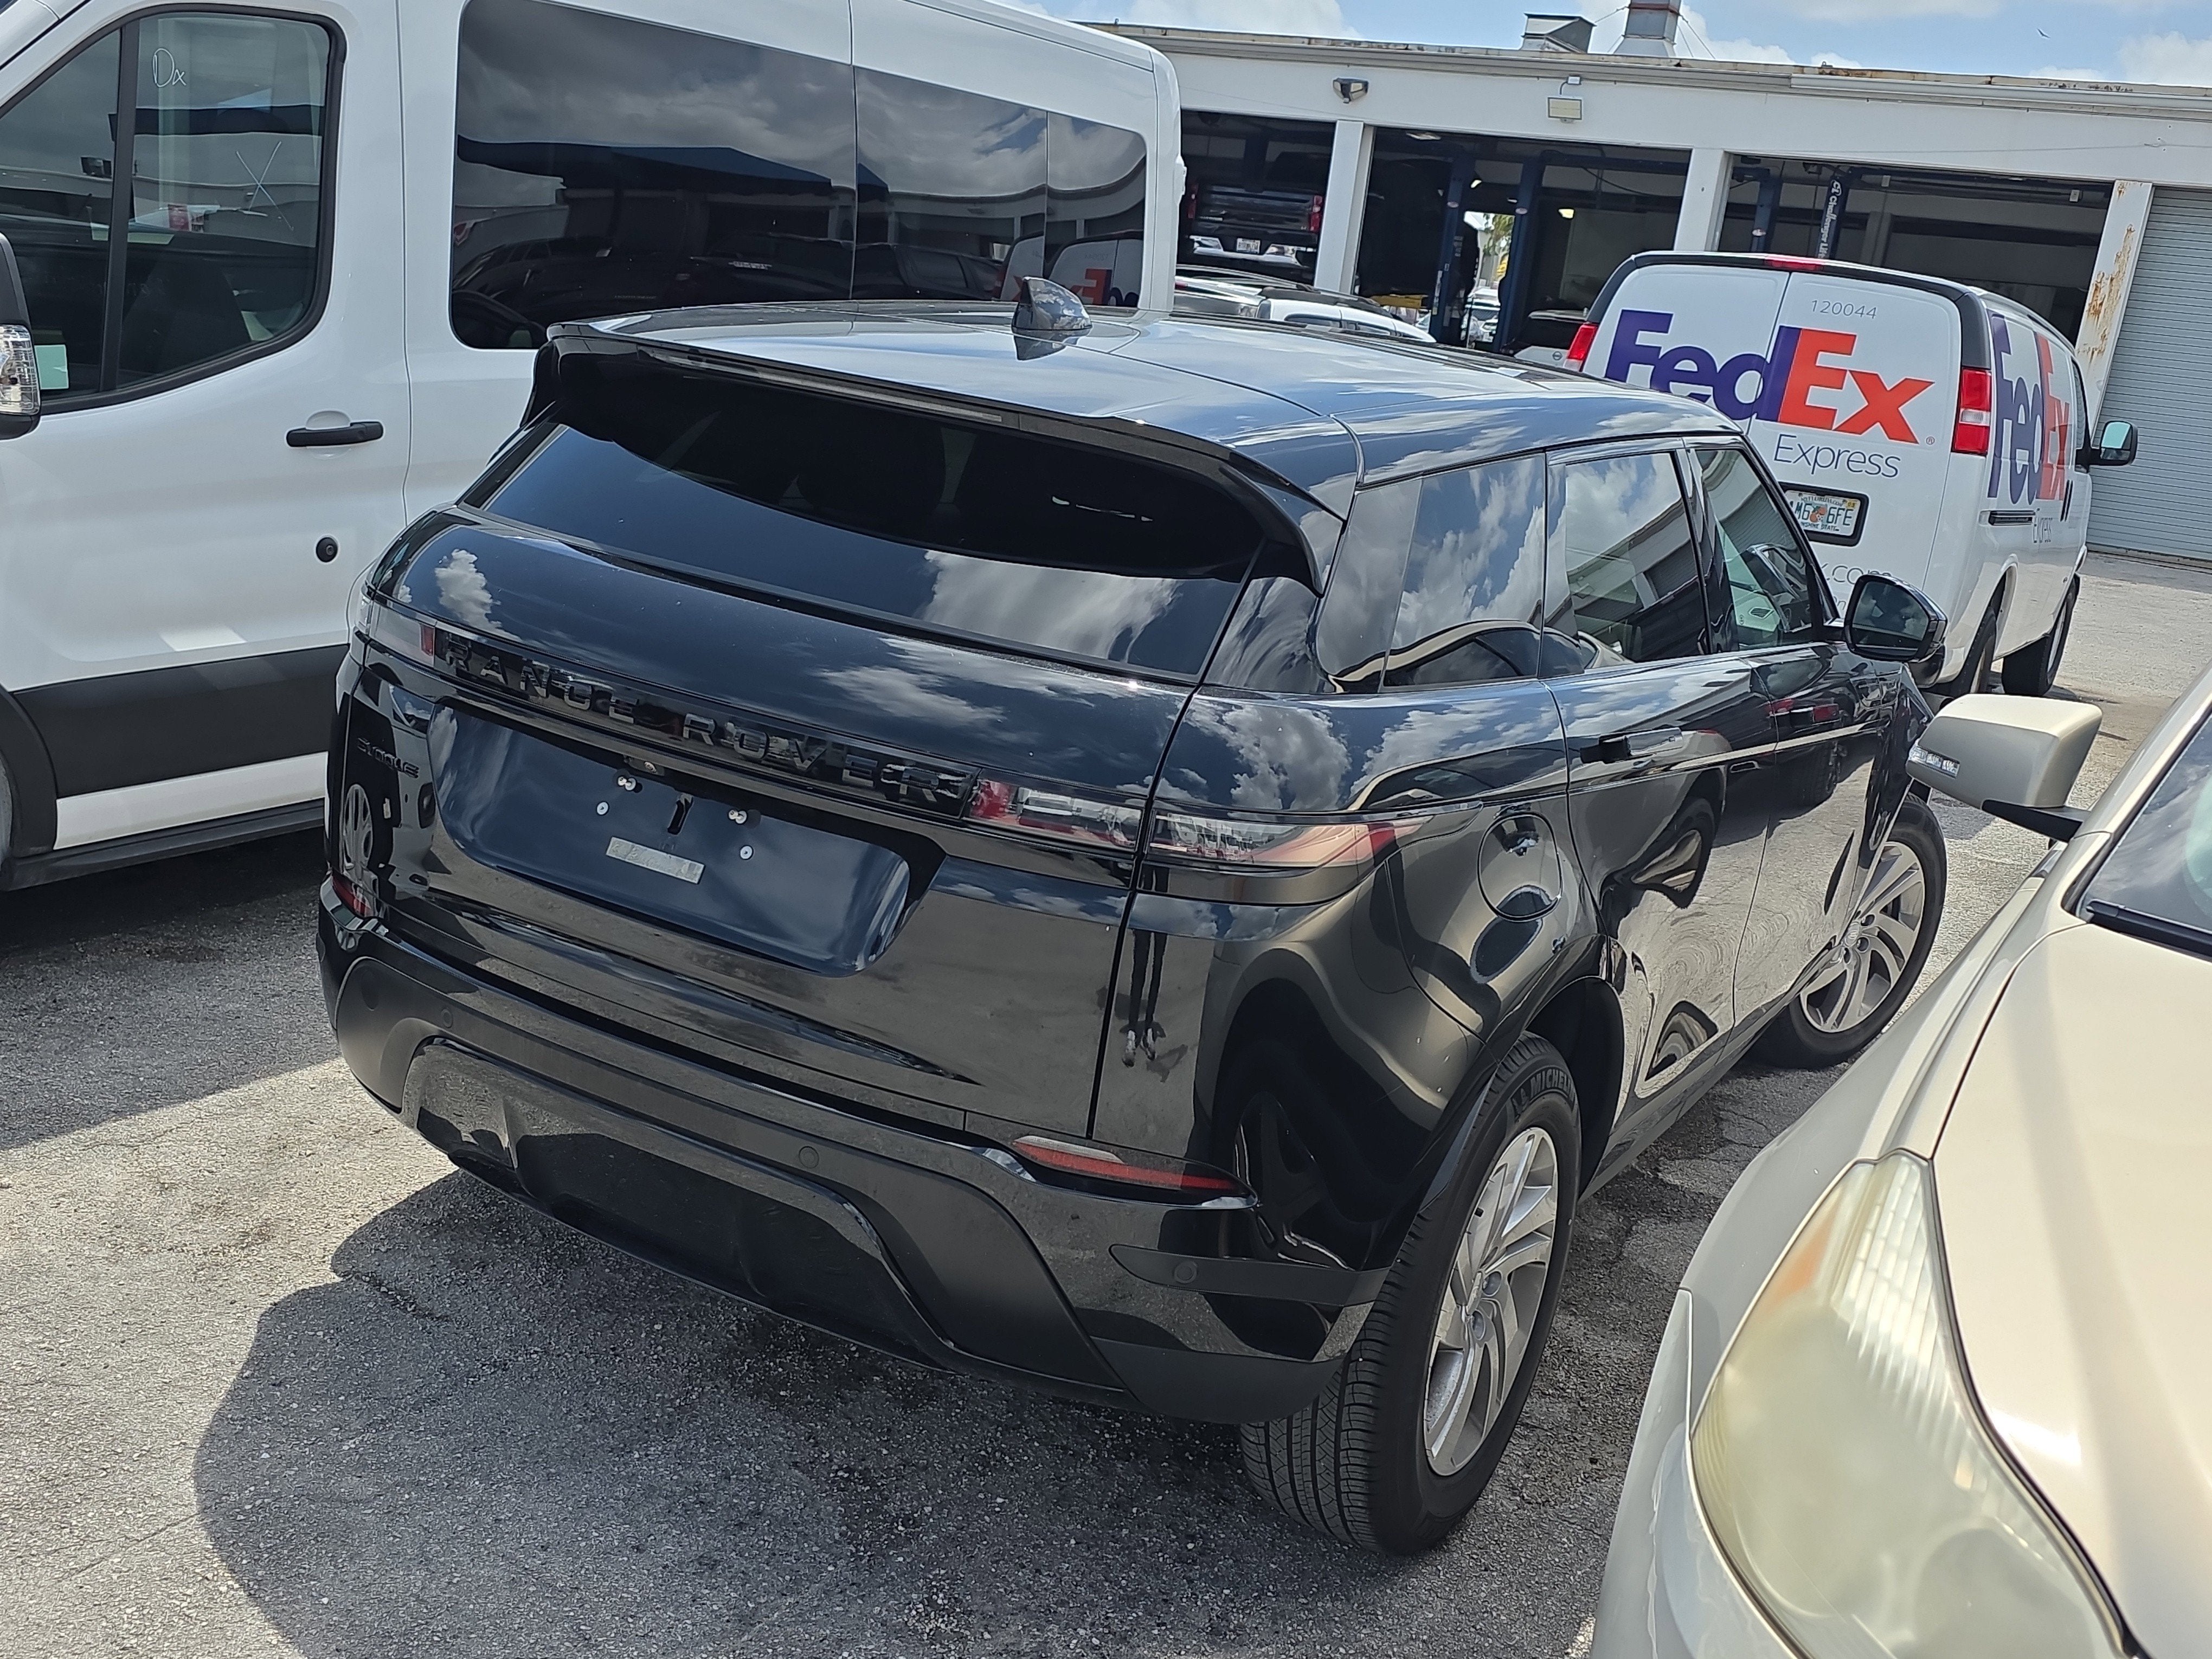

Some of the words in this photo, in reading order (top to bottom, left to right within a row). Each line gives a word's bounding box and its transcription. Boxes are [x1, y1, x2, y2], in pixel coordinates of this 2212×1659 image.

[1810, 299, 1877, 319] 120044
[1605, 308, 1936, 445] FedEx
[1986, 308, 2070, 505] FedEx
[1773, 433, 1901, 478] Express
[1826, 506, 1854, 526] 6FE
[445, 636, 638, 725] RANGE
[682, 712, 940, 803] ROVER
